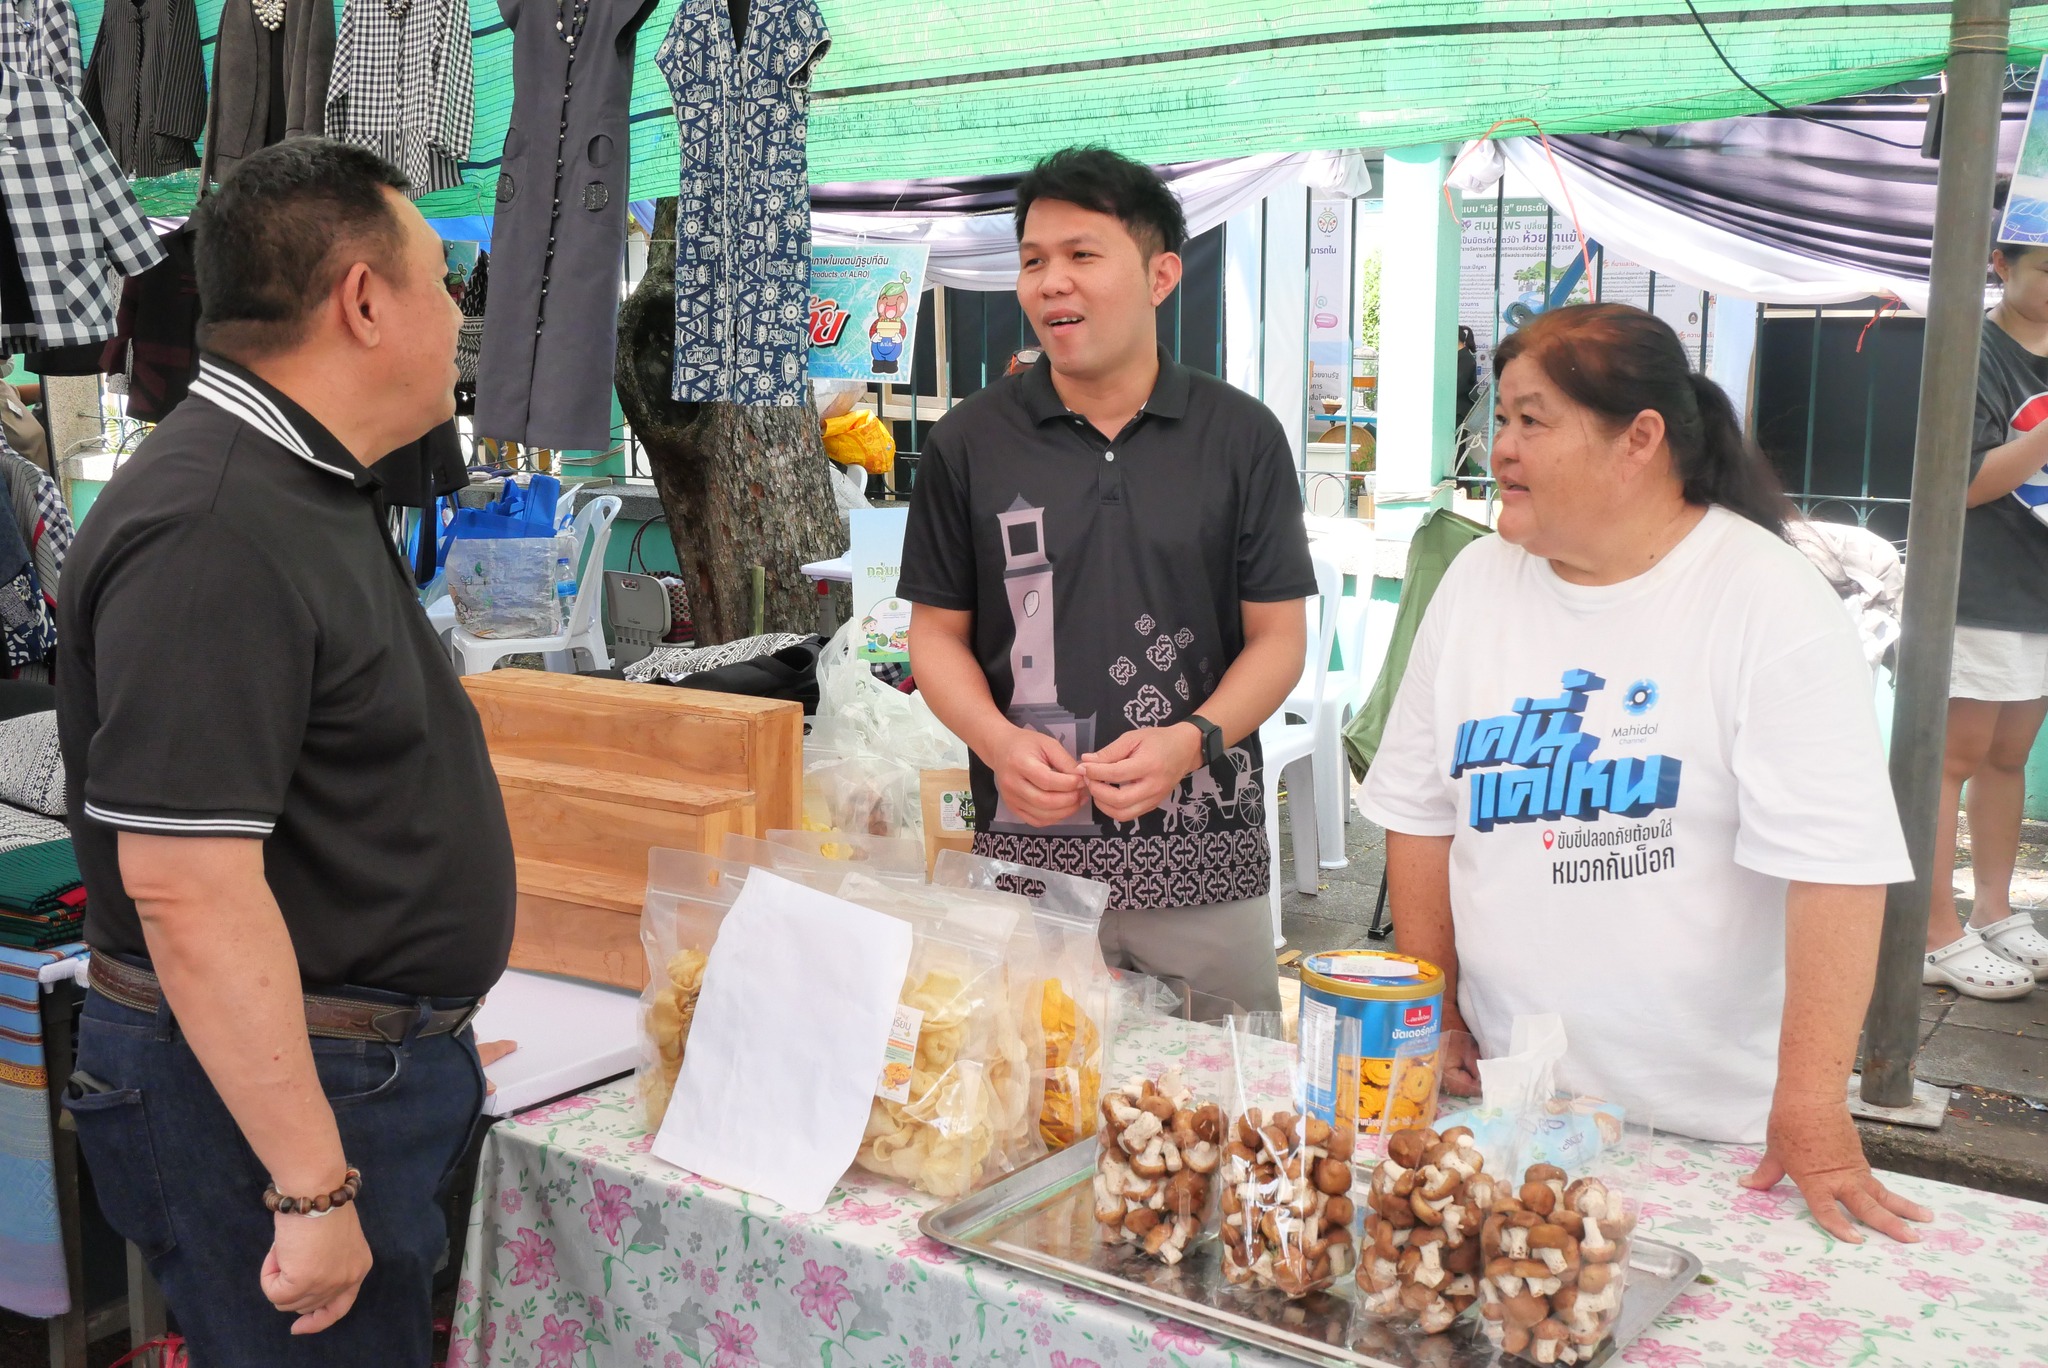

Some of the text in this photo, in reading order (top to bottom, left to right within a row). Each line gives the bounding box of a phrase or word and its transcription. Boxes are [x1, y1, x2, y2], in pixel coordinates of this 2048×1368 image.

[811, 253, 889, 268] ภาพในเขตปฏิรูปที่ดิน
[840, 270, 847, 278] of
[1611, 723, 1659, 738] Mahidol
[1619, 737, 1648, 745] Channel
[1557, 817, 1673, 850] ขับขี่ปลอดภัยต้องใส่
[1552, 843, 1675, 885] หมวกกันน็อก
